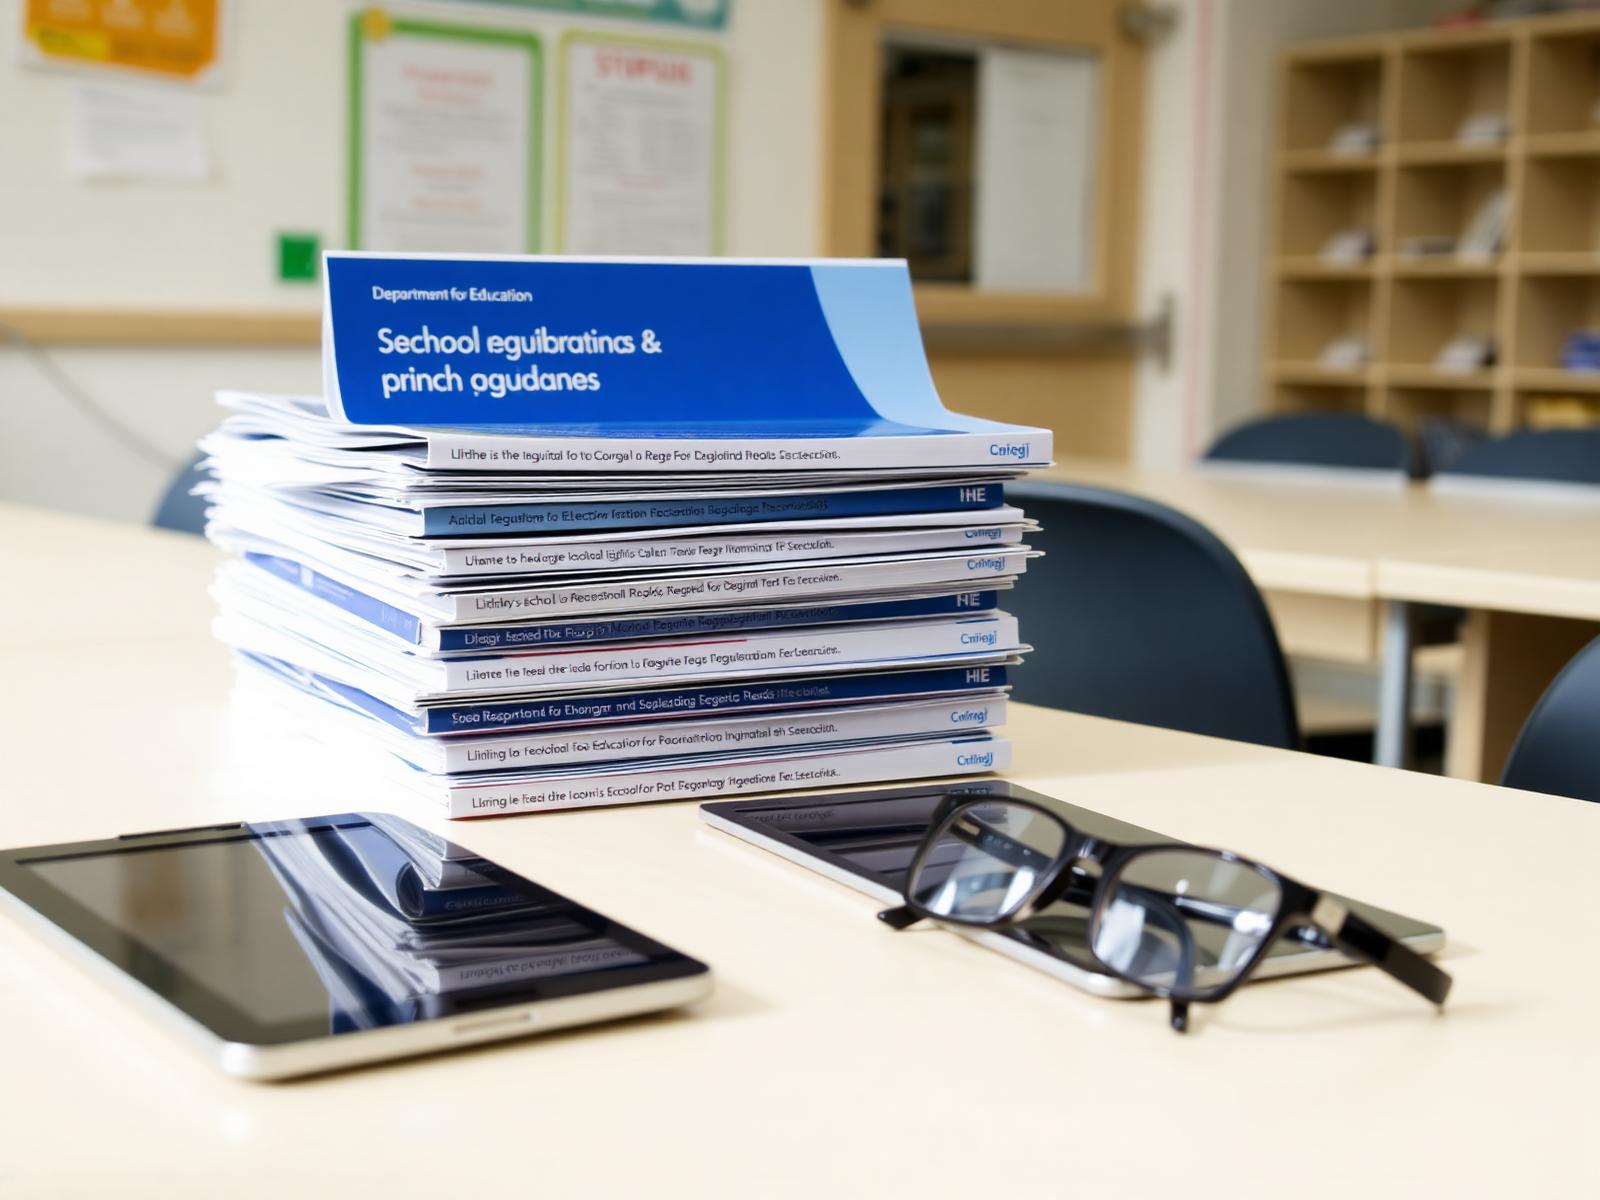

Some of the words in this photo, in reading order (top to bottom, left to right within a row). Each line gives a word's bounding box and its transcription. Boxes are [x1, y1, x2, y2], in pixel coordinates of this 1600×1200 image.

[371, 285, 449, 303] Department
[468, 287, 534, 302] Education
[377, 324, 481, 354] Sechool
[641, 328, 663, 354] &
[381, 363, 464, 399] princh
[501, 448, 520, 461] the
